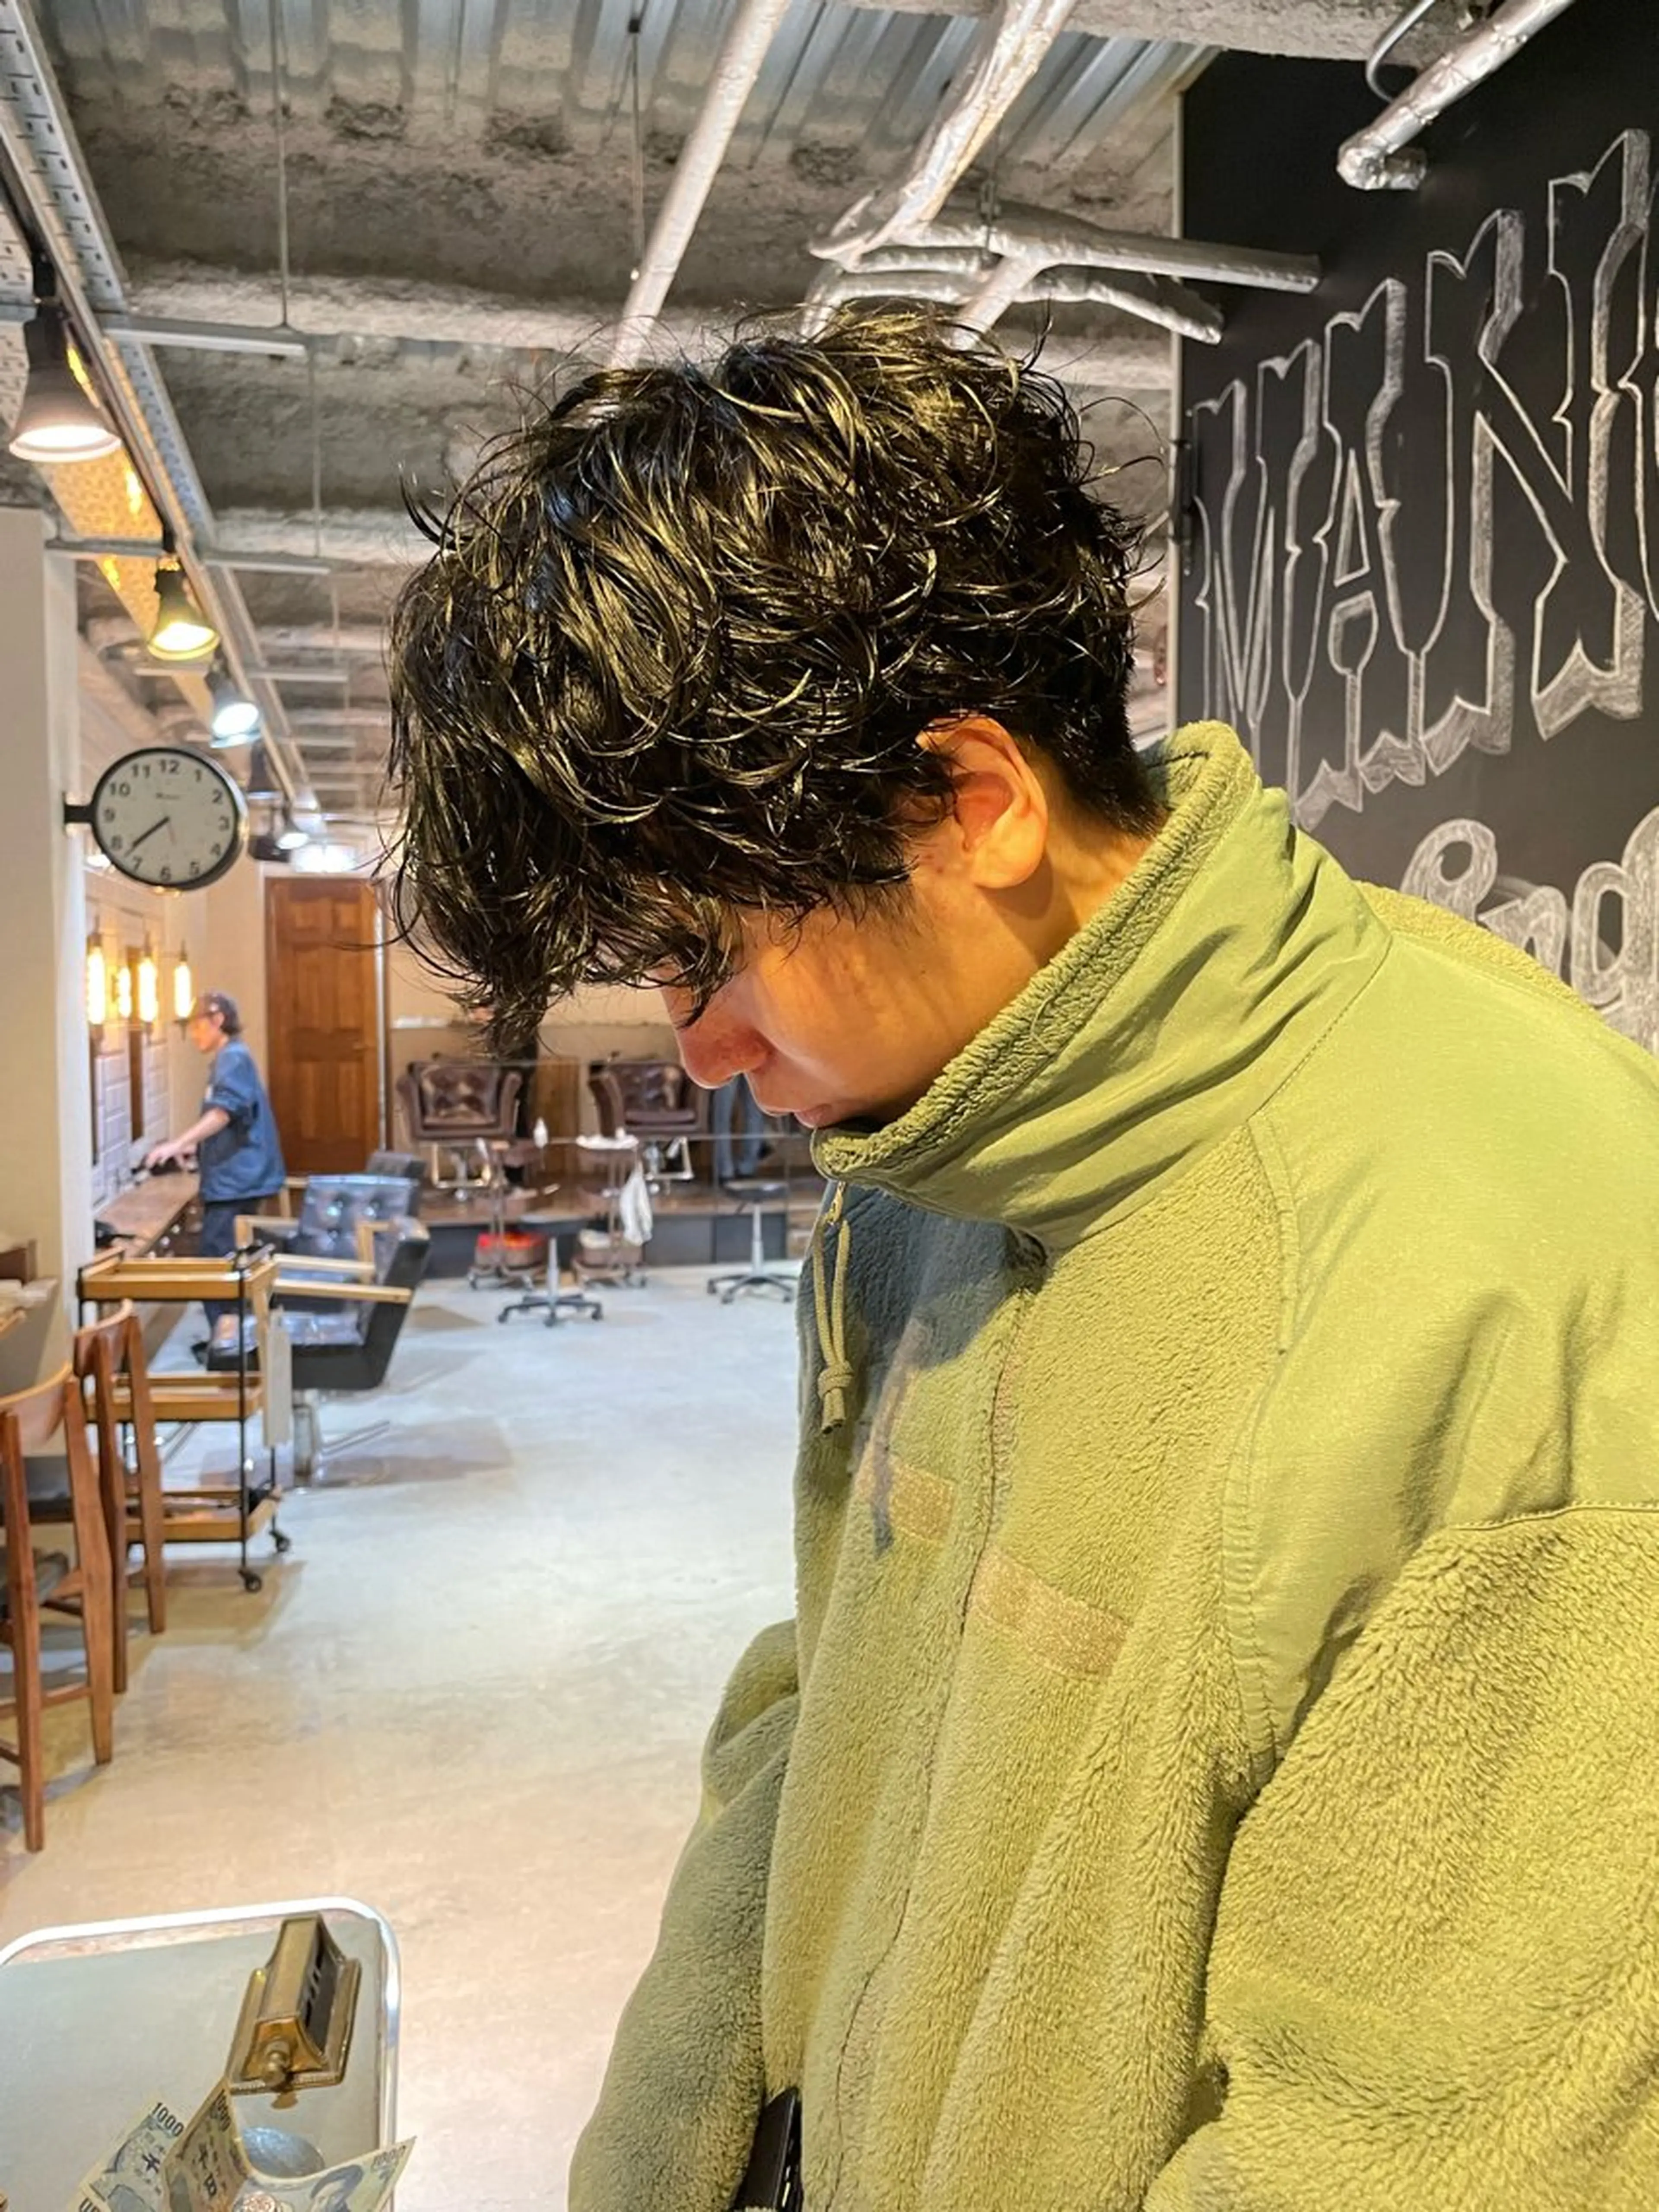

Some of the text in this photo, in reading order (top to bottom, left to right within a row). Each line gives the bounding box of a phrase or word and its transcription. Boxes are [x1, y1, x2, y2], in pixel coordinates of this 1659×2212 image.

[131, 763, 151, 778] 11
[159, 759, 180, 774] 12
[194, 769, 202, 782] 1
[109, 782, 130, 797] 10
[212, 789, 223, 804] 2
[218, 816, 230, 831] 3
[210, 843, 221, 855] 4
[132, 856, 143, 872] 7
[189, 861, 200, 877] 5
[159, 867, 171, 882] 6
[152, 2102, 184, 2137] 1000
